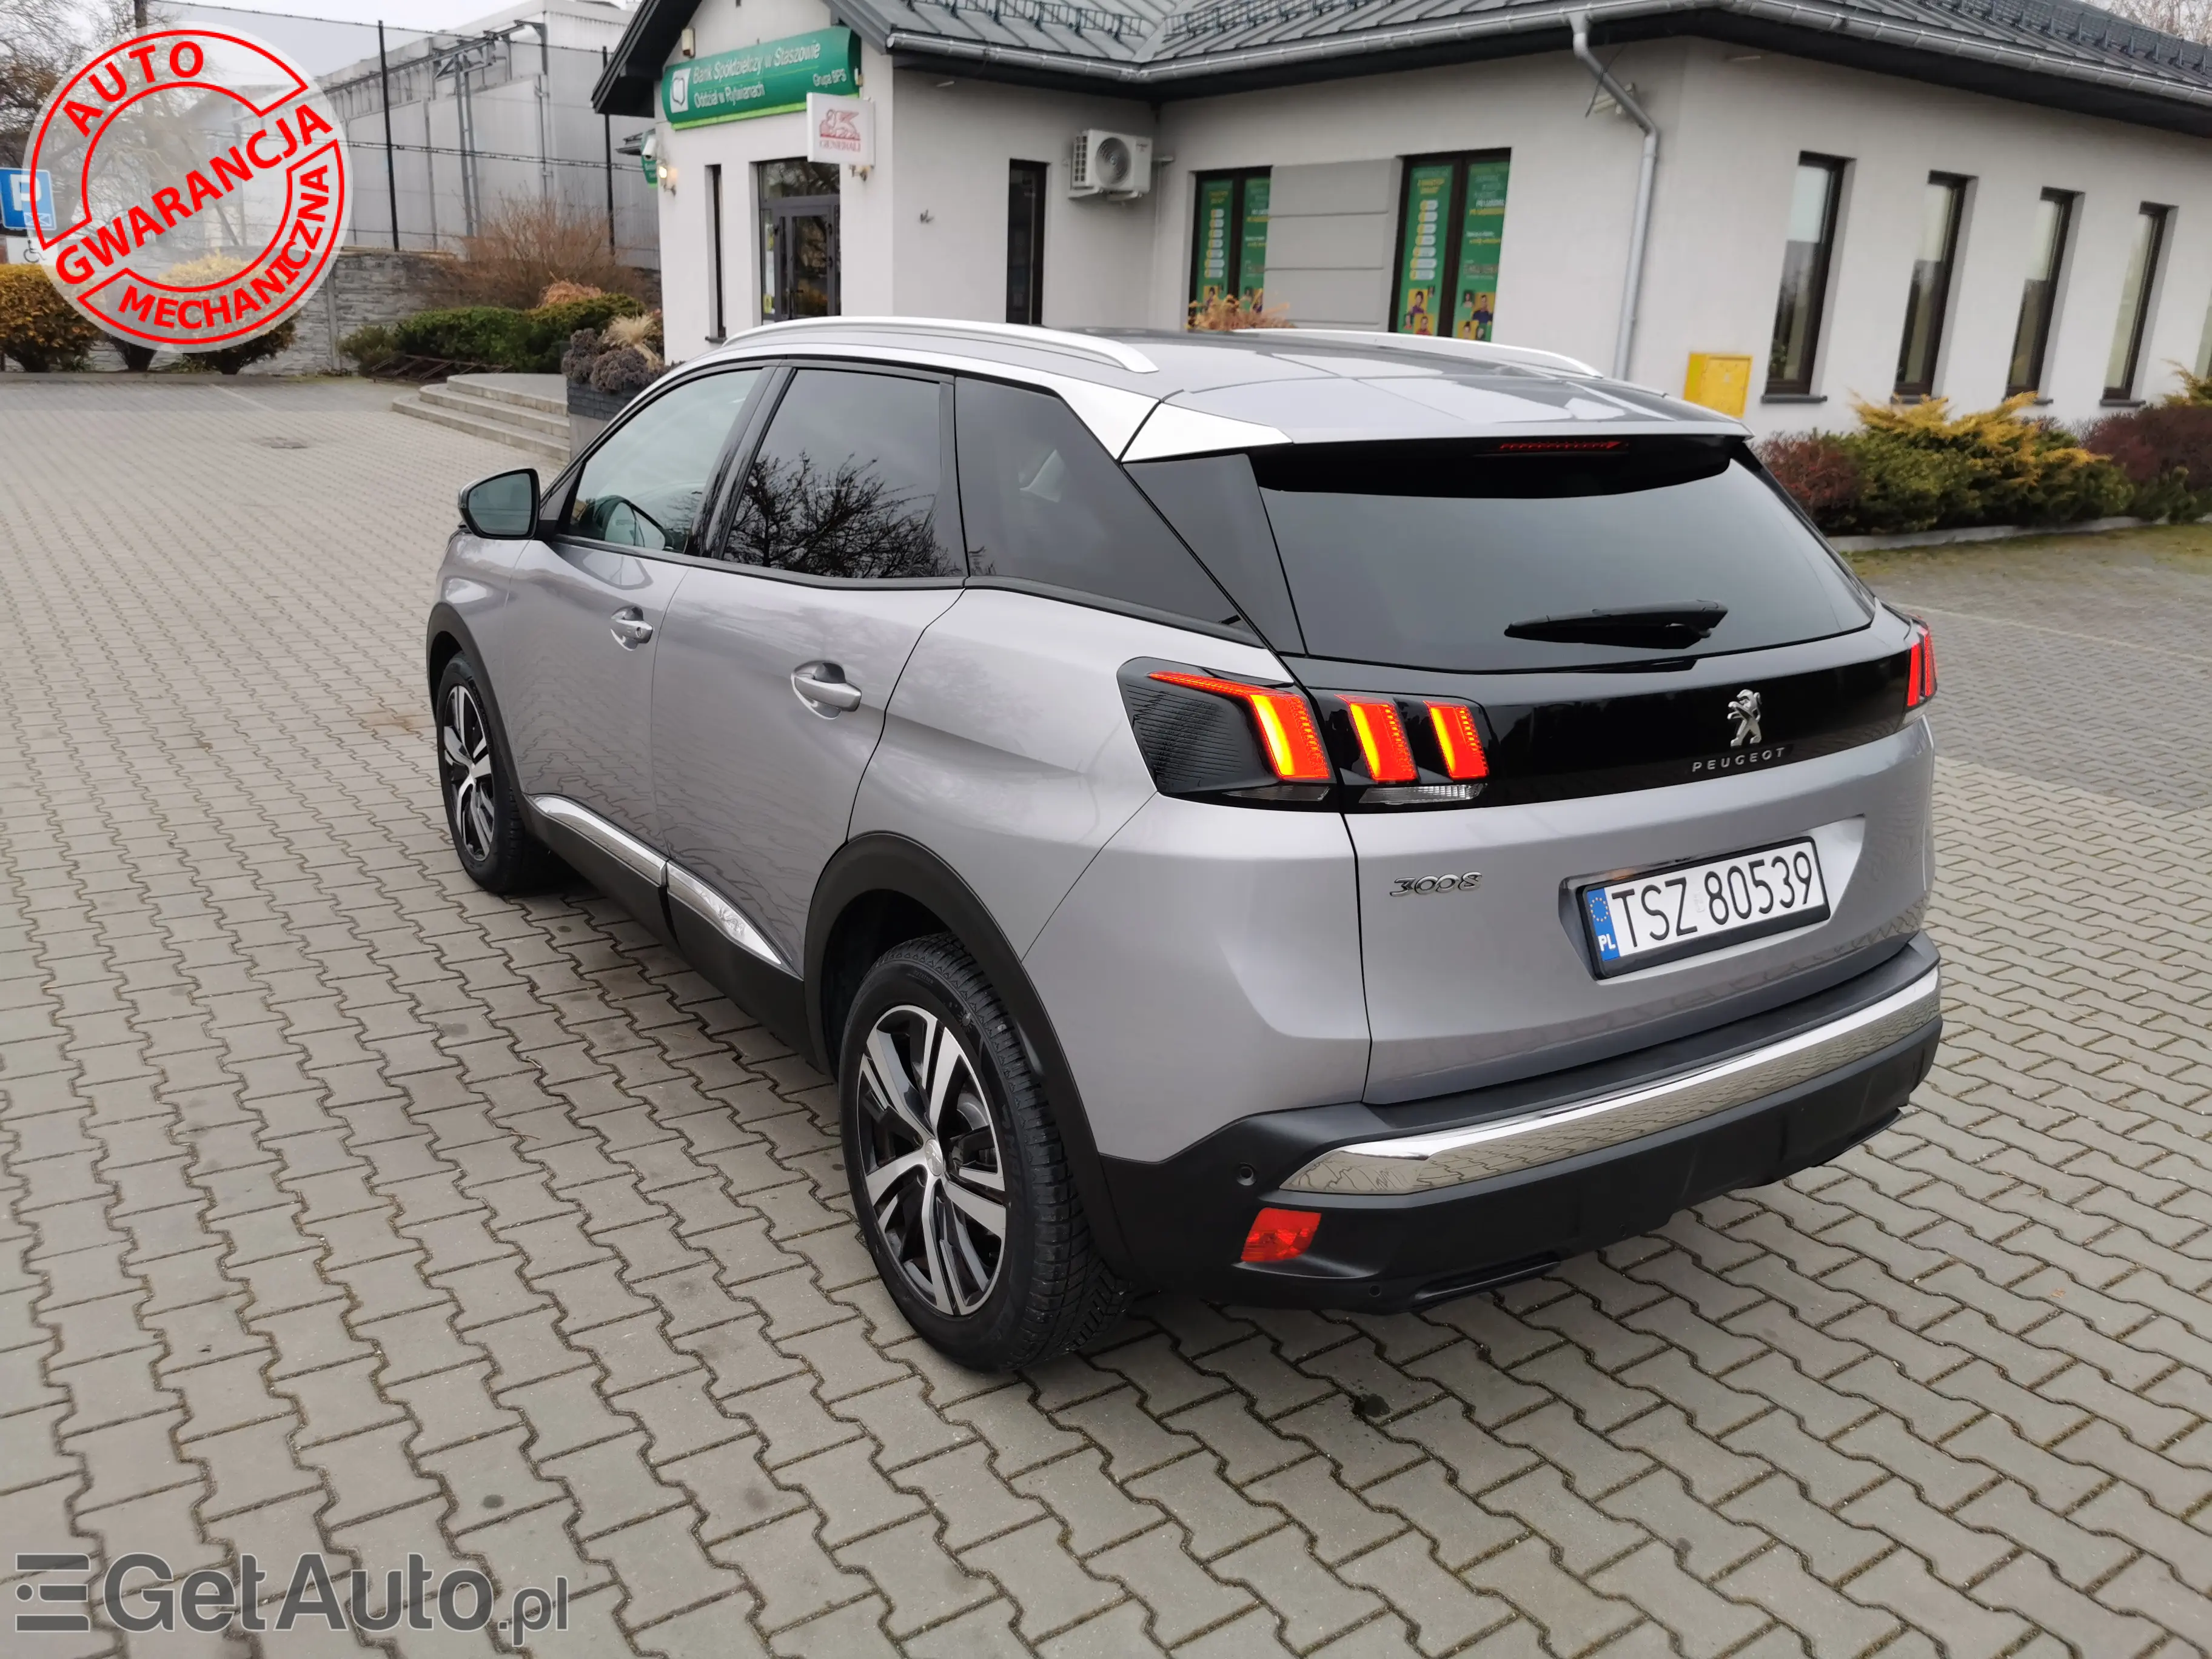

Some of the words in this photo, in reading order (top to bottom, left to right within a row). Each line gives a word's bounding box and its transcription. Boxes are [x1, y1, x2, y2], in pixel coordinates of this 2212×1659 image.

[10, 173, 42, 212] P
[1692, 747, 1785, 773] PEUGEOT
[1389, 871, 1483, 897] 3008
[1611, 877, 1698, 948] TSZ
[1704, 851, 1812, 925] 80539
[1598, 934, 1617, 953] PL
